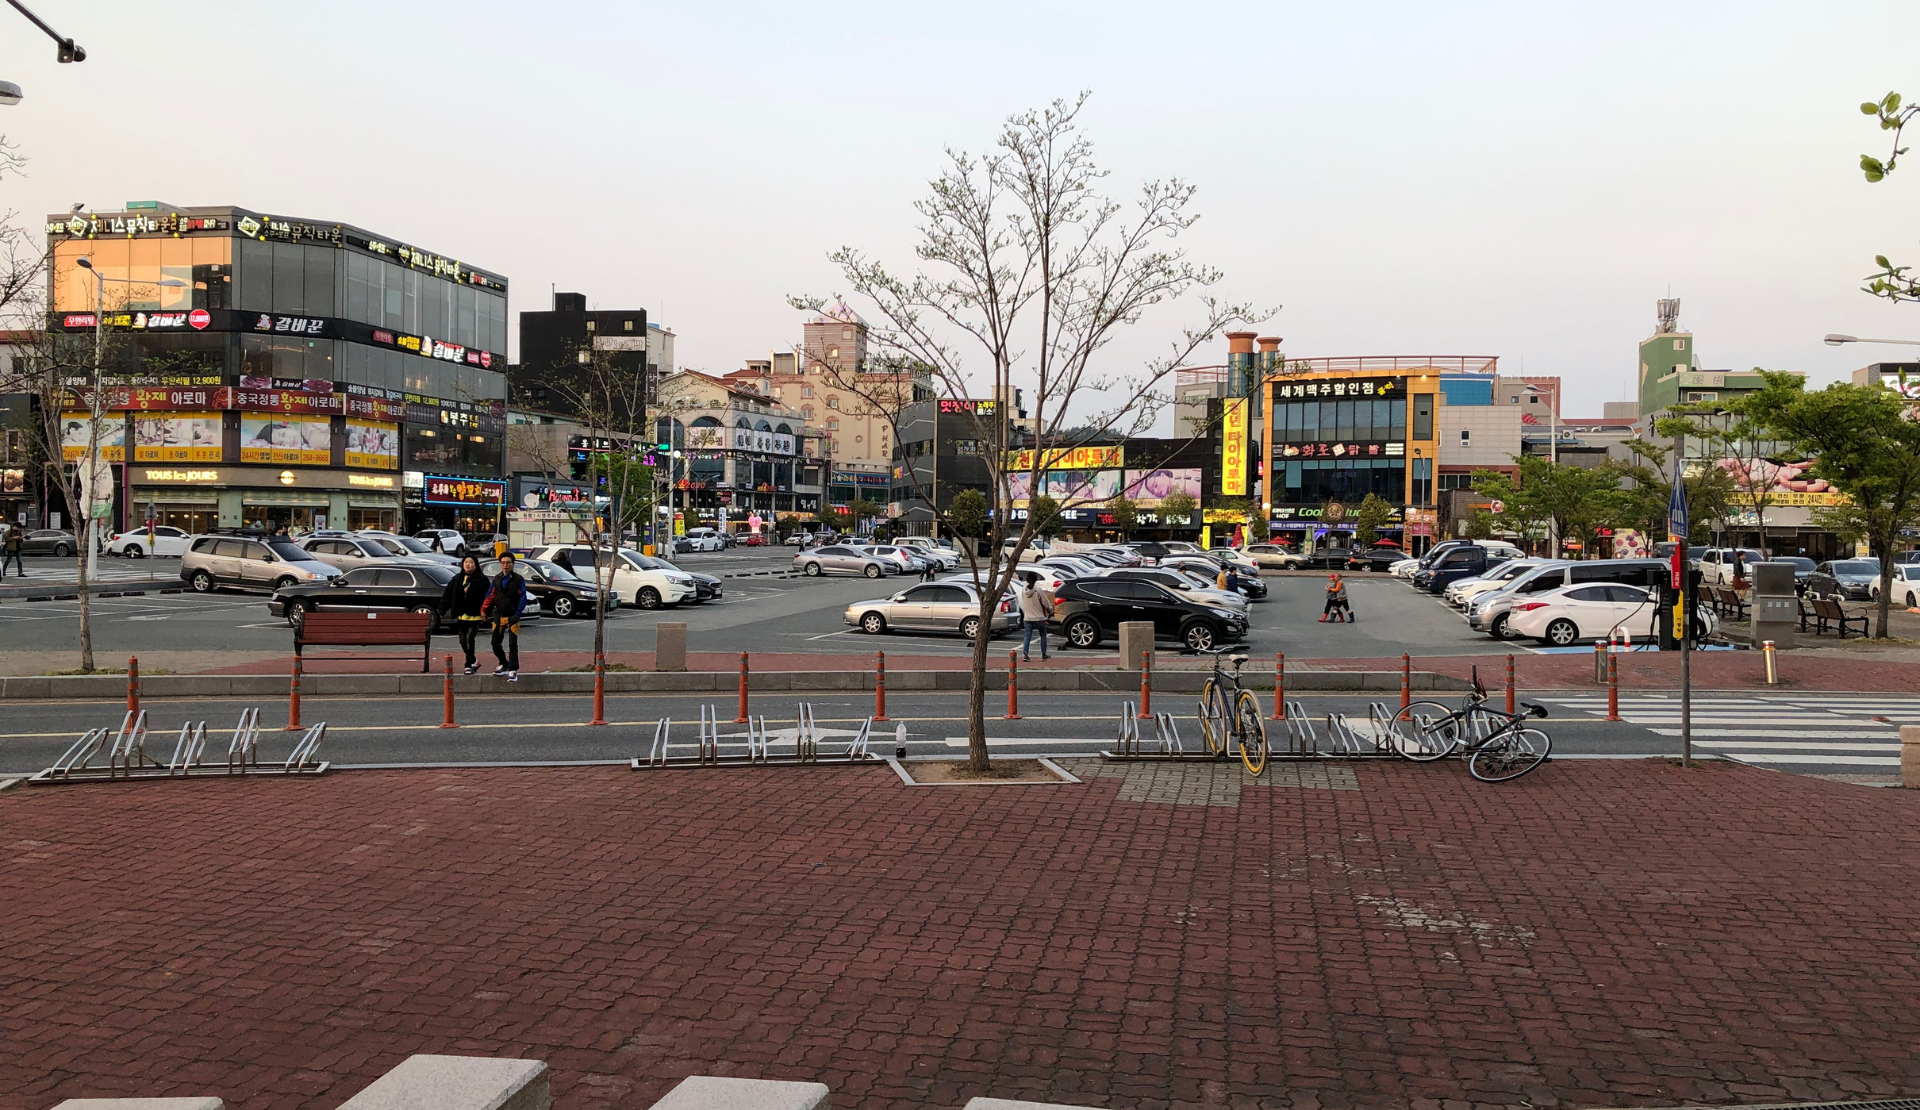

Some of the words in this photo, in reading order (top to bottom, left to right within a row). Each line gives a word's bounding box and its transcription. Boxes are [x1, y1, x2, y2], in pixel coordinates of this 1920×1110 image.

[292, 225, 342, 244] 뮤직타운
[411, 251, 434, 270] 제니스
[275, 316, 324, 334] 갈비꾼
[192, 376, 221, 386] 12,900원
[1280, 382, 1374, 398] 세계맥주할인점
[171, 391, 206, 405] 아로마
[237, 392, 280, 406] 중국정통
[280, 391, 308, 411] 황제
[308, 396, 339, 409] 아로마
[350, 399, 373, 414] 중국정통
[372, 399, 387, 418] 황제
[387, 405, 403, 417] 아로마
[450, 411, 468, 427] 봉추
[145, 451, 159, 459] 아로마
[174, 451, 188, 459] 아로마
[283, 453, 300, 461] 아로마
[302, 453, 328, 462] 284-8668
[1227, 431, 1242, 493] 타이아로마
[145, 470, 172, 480] TOUS
[173, 470, 186, 480] les
[186, 470, 218, 482] JOURS
[348, 475, 366, 485] TOUS
[373, 476, 393, 487] JOURS
[1298, 507, 1324, 517] Cool
